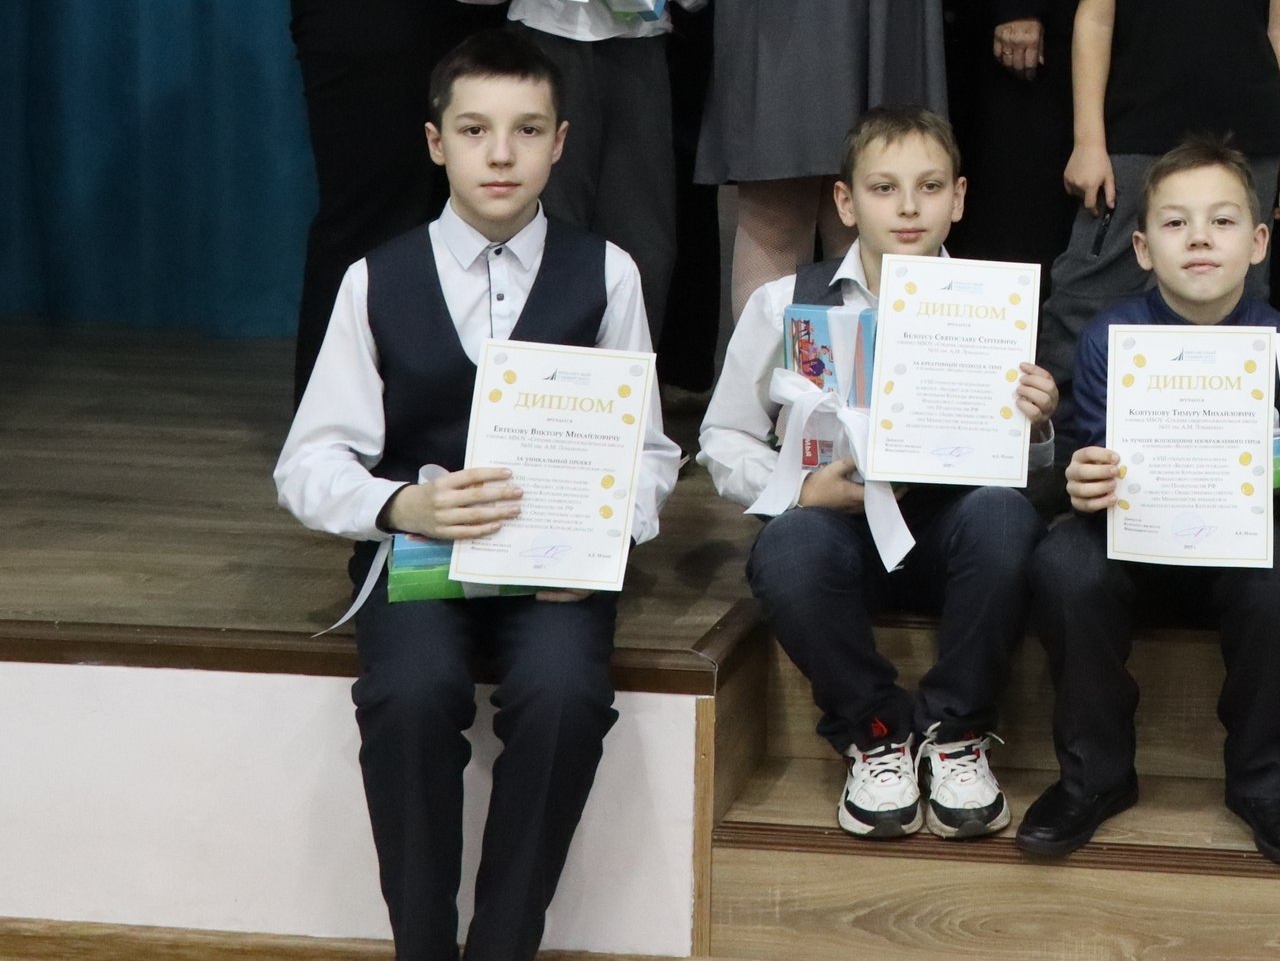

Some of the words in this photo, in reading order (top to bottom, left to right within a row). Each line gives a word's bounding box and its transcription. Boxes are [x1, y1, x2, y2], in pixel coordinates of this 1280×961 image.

[916, 302, 1007, 320] ДИПЛОМ
[1147, 375, 1243, 392] ДИПЛОМ
[514, 392, 615, 414] ДИПЛОМ
